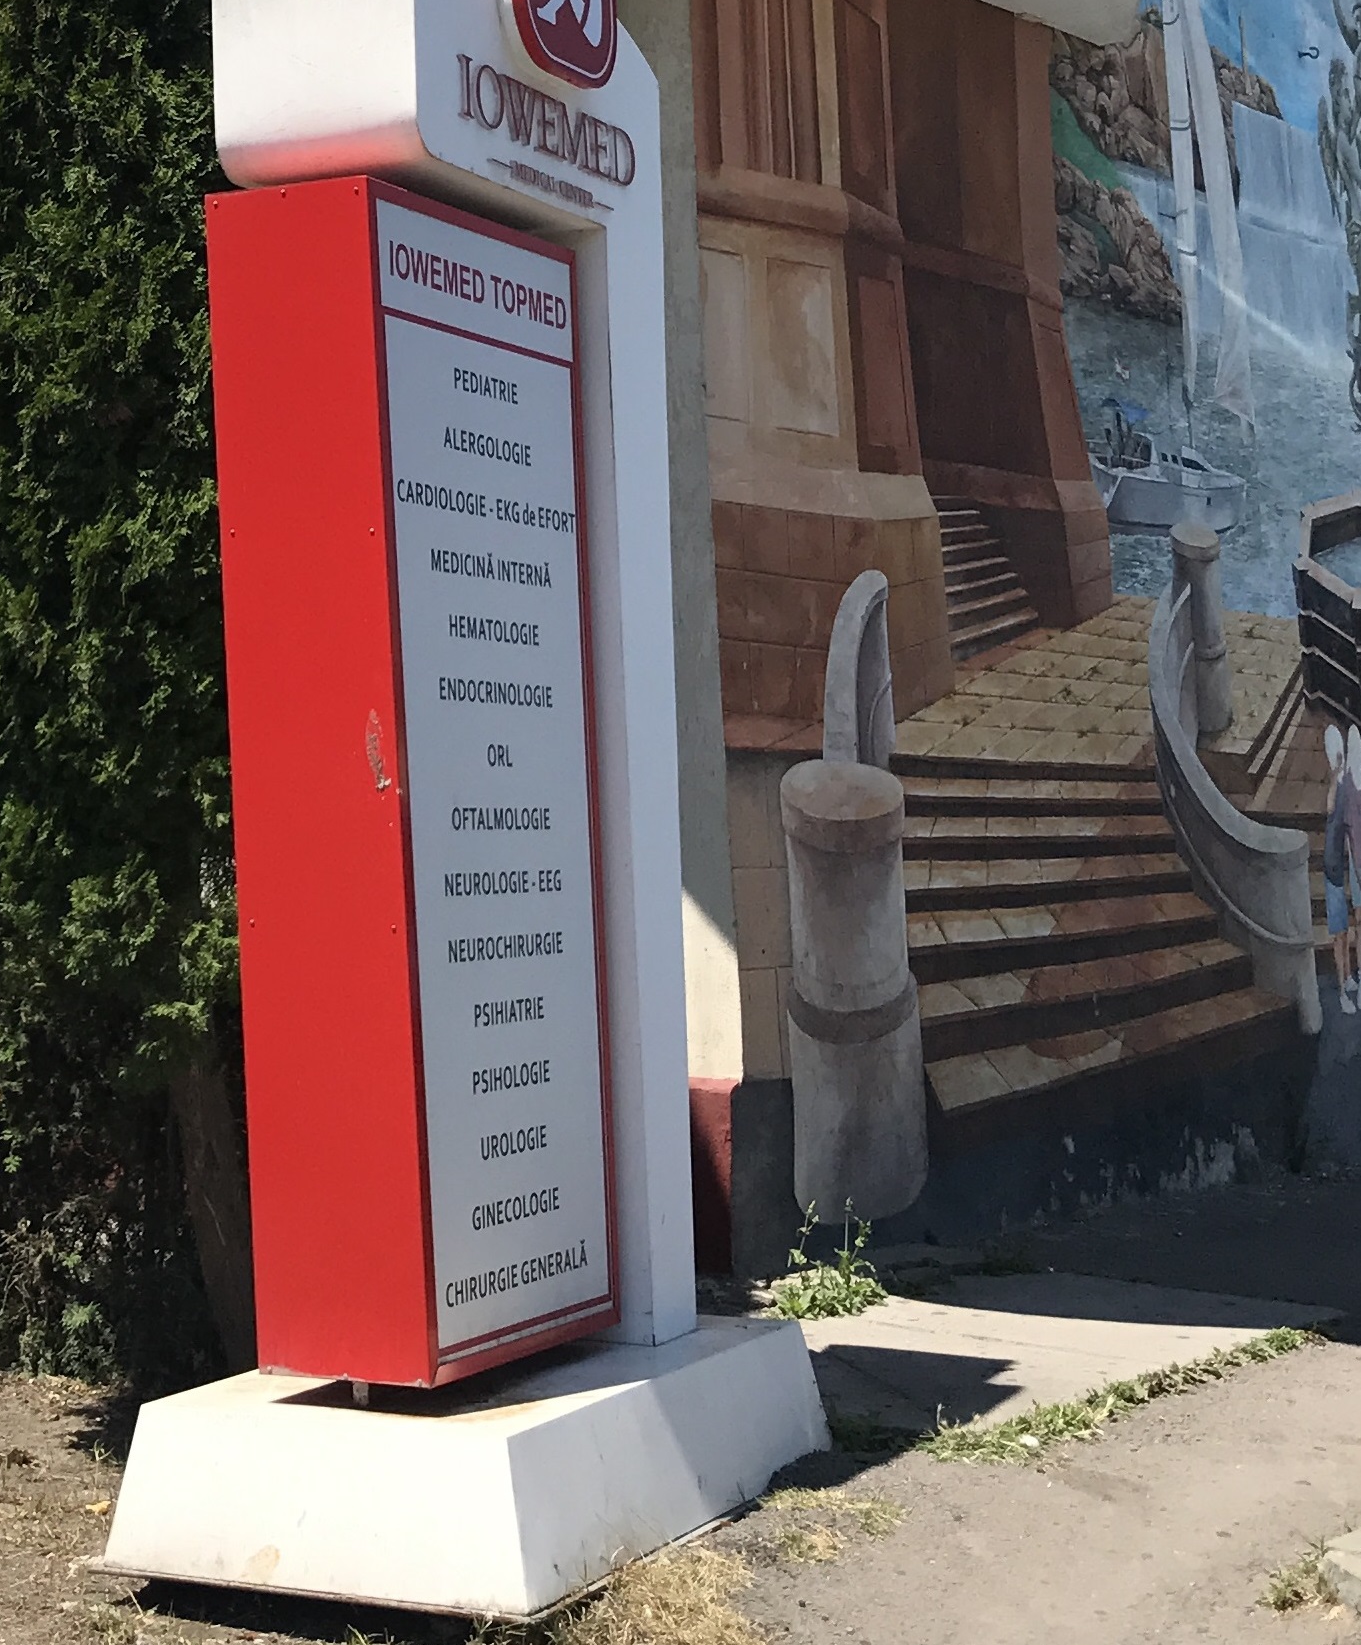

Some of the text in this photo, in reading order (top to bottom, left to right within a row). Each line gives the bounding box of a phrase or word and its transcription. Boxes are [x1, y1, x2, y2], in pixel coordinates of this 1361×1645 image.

[456, 53, 636, 187] IOWEMED
[389, 240, 567, 330] IOWEMED TOPMED
[453, 367, 519, 405] PEDIATRIE
[443, 426, 532, 467] ALERGOLOGIE
[397, 478, 487, 518] CARDIOLOGIE
[496, 498, 520, 524] EKG
[522, 502, 536, 527] de
[538, 506, 575, 534] EFORT
[430, 548, 552, 589] MEDICINĂ INTERNĂ
[448, 614, 540, 647] HEMATOLOGIE
[439, 676, 553, 708] ENDOCRINOLOGIE
[487, 743, 513, 768] ORL
[451, 806, 551, 831] OFTALMOLOGIE
[444, 870, 530, 897] NEUROLOGIE
[539, 869, 562, 893] EEG
[448, 931, 564, 964] NEUROCHIRURGIE
[473, 996, 545, 1028] PSIHIATRIE
[472, 1059, 551, 1095] PSIHOLOGIE
[480, 1124, 547, 1161] UROLOGIE
[471, 1186, 560, 1231] GINECOLOGIE
[445, 1239, 588, 1308] CHIRURGIE GENERALĂ
